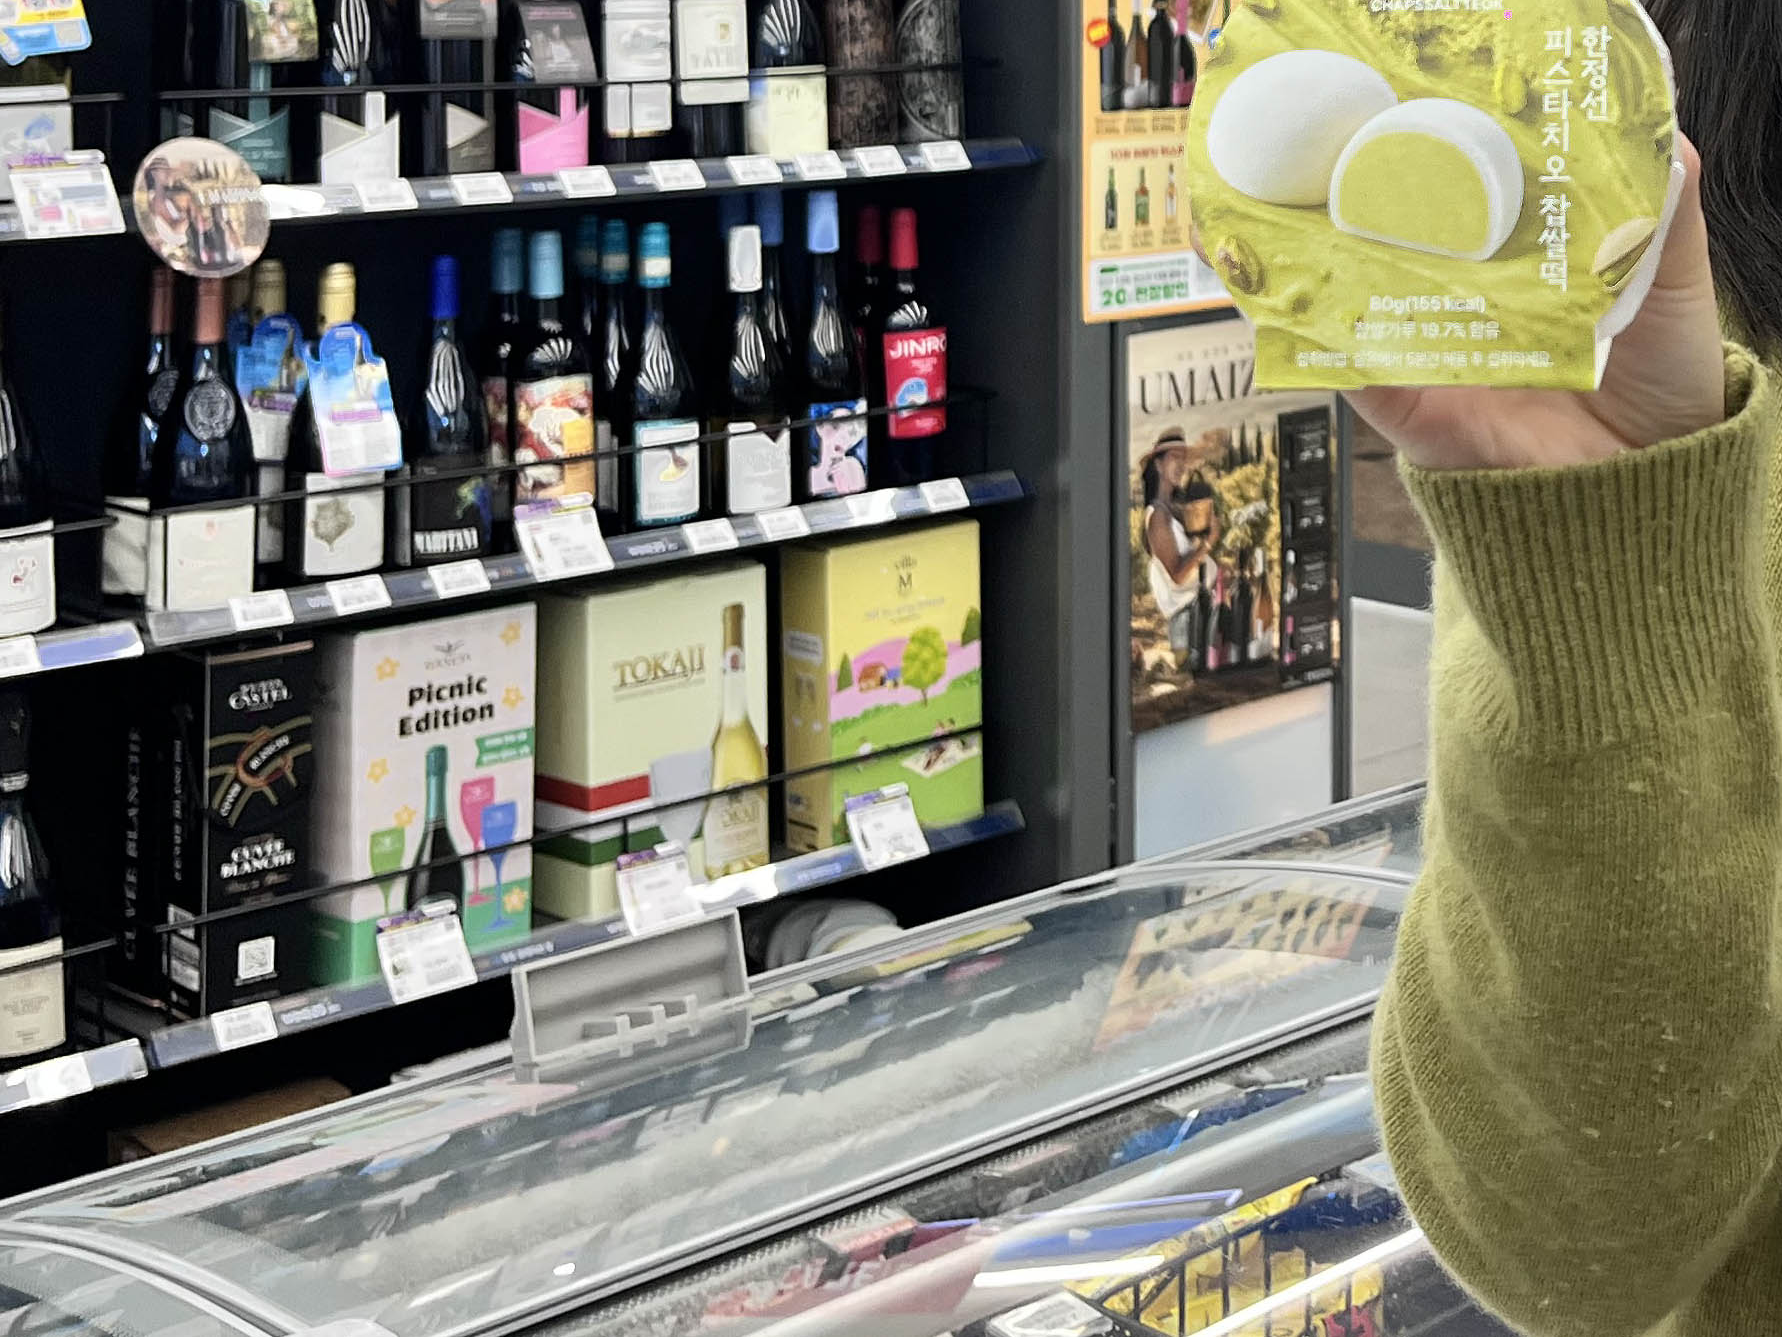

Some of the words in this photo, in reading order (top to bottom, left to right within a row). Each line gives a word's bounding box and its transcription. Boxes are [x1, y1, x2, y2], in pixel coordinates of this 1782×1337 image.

[1580, 25, 1613, 122] 한정선
[1538, 26, 1574, 183] 피스타치오
[1537, 193, 1572, 294] 찹쌀떡
[889, 333, 947, 360] JINRO
[1138, 357, 1256, 414] UMAIZ
[408, 674, 488, 707] Picnic
[398, 702, 495, 737] Edition
